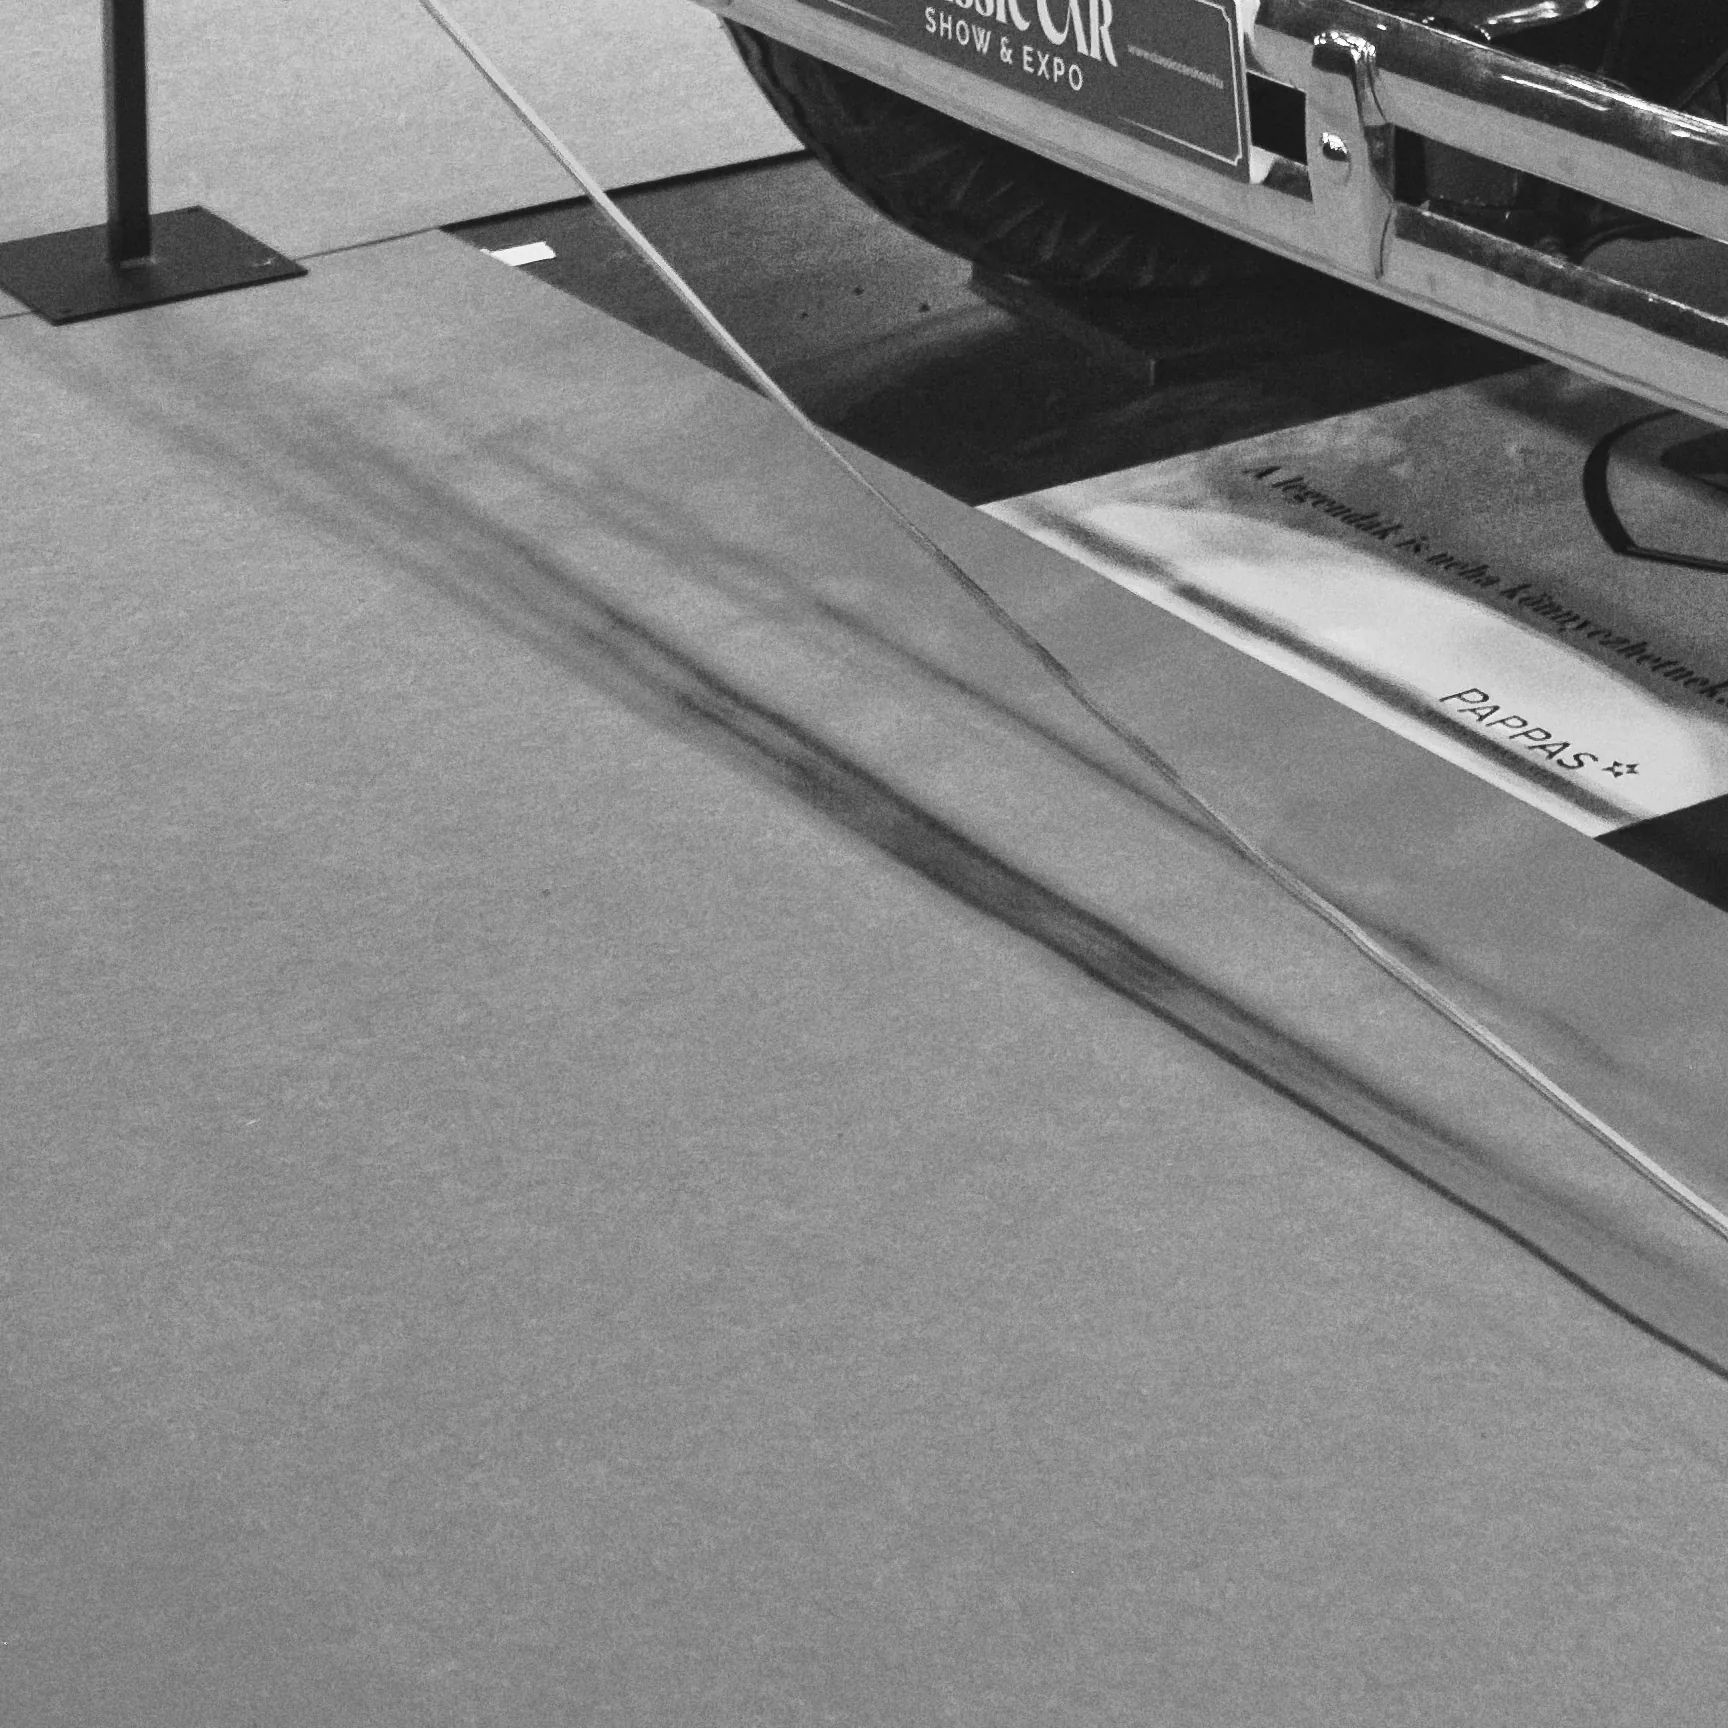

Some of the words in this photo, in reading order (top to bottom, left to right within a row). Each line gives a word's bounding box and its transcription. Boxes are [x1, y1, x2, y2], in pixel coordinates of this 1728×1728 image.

[924, 6, 992, 55] SHOW
[1000, 36, 1013, 65] &
[1022, 44, 1084, 91] EXPO
[1438, 687, 1599, 770] PAPPAS
